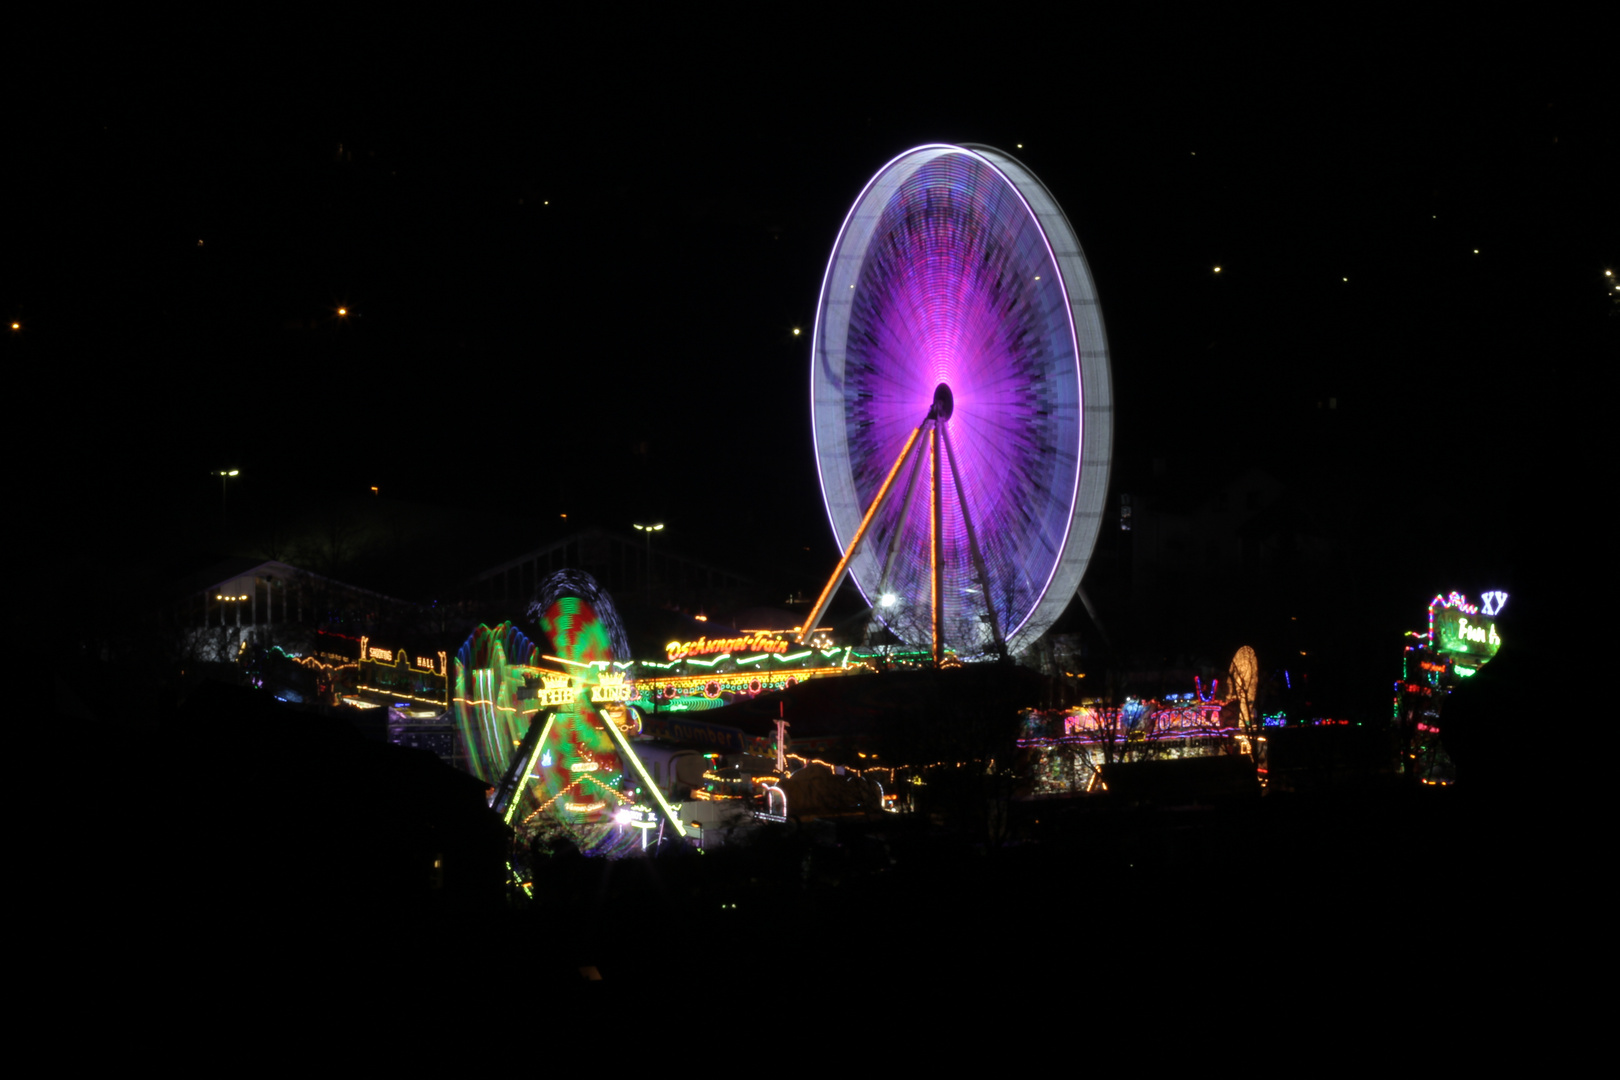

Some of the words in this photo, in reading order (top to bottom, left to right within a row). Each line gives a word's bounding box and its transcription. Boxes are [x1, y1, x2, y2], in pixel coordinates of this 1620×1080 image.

[1481, 591, 1508, 616] XY
[417, 656, 434, 669] HALL
[538, 687, 575, 706] THE
[591, 684, 631, 702] KING
[1151, 705, 1222, 733] TOMBOLA
[674, 724, 732, 746] number
